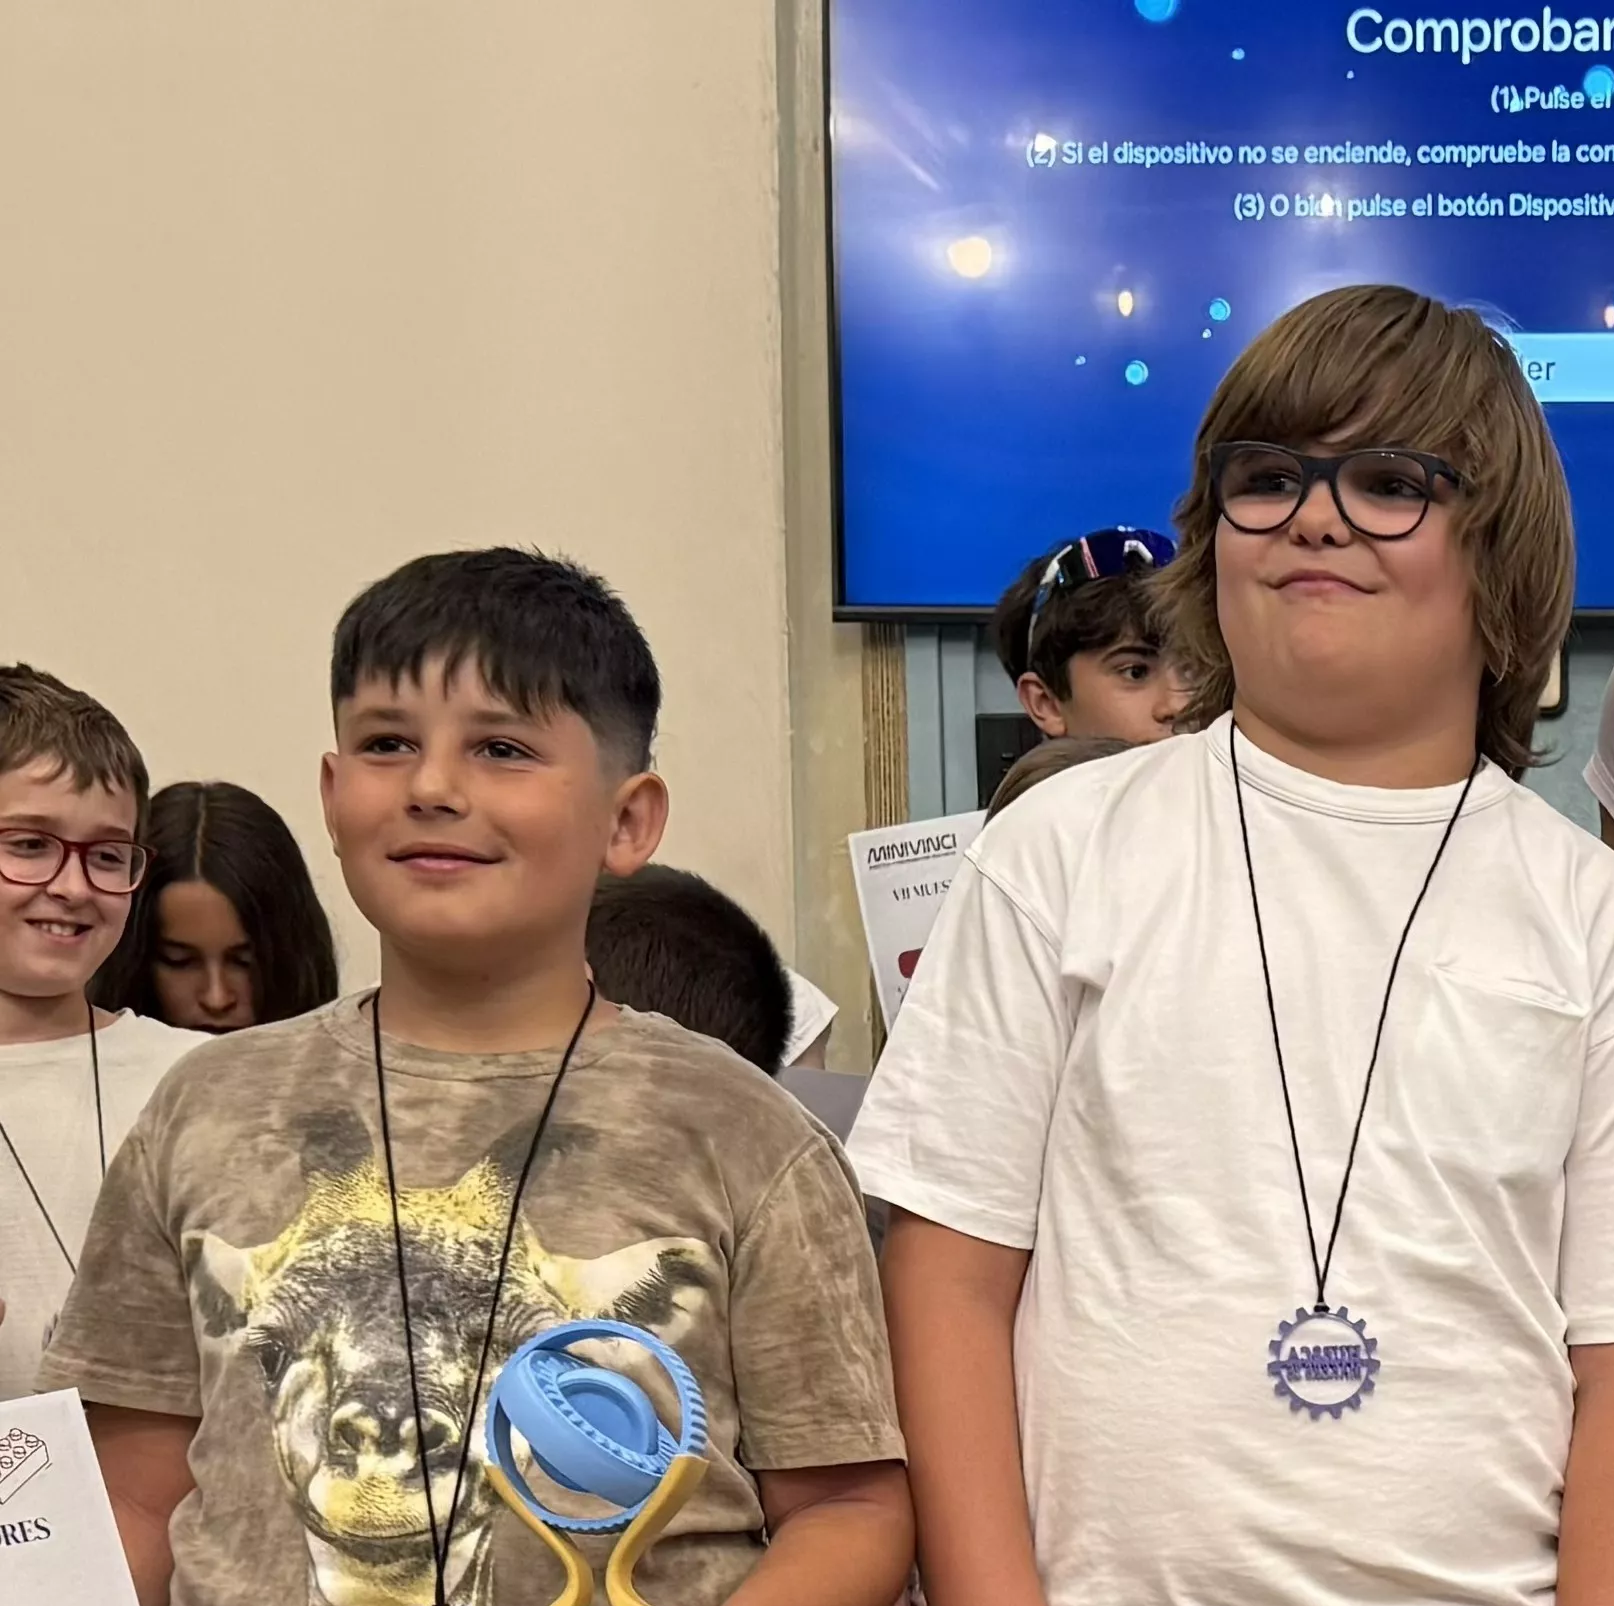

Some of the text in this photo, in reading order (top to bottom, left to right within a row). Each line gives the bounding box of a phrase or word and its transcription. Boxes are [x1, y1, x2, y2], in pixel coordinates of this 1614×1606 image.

[1525, 86, 1584, 110] Pulse
[1591, 85, 1610, 109] el
[1062, 142, 1083, 165] Si
[1088, 141, 1109, 164] el
[1113, 141, 1233, 168] dispositivo
[1238, 147, 1267, 165] no
[1271, 146, 1299, 165] se
[1303, 141, 1411, 166] enciende,
[1417, 140, 1546, 167] compruebe
[1551, 140, 1571, 163] la
[1234, 193, 1265, 221] (3)
[1270, 194, 1290, 217] O
[1348, 193, 1406, 221] pulse
[1412, 193, 1433, 217] el
[1438, 192, 1504, 217] botón
[867, 832, 957, 864] MINIVINCI
